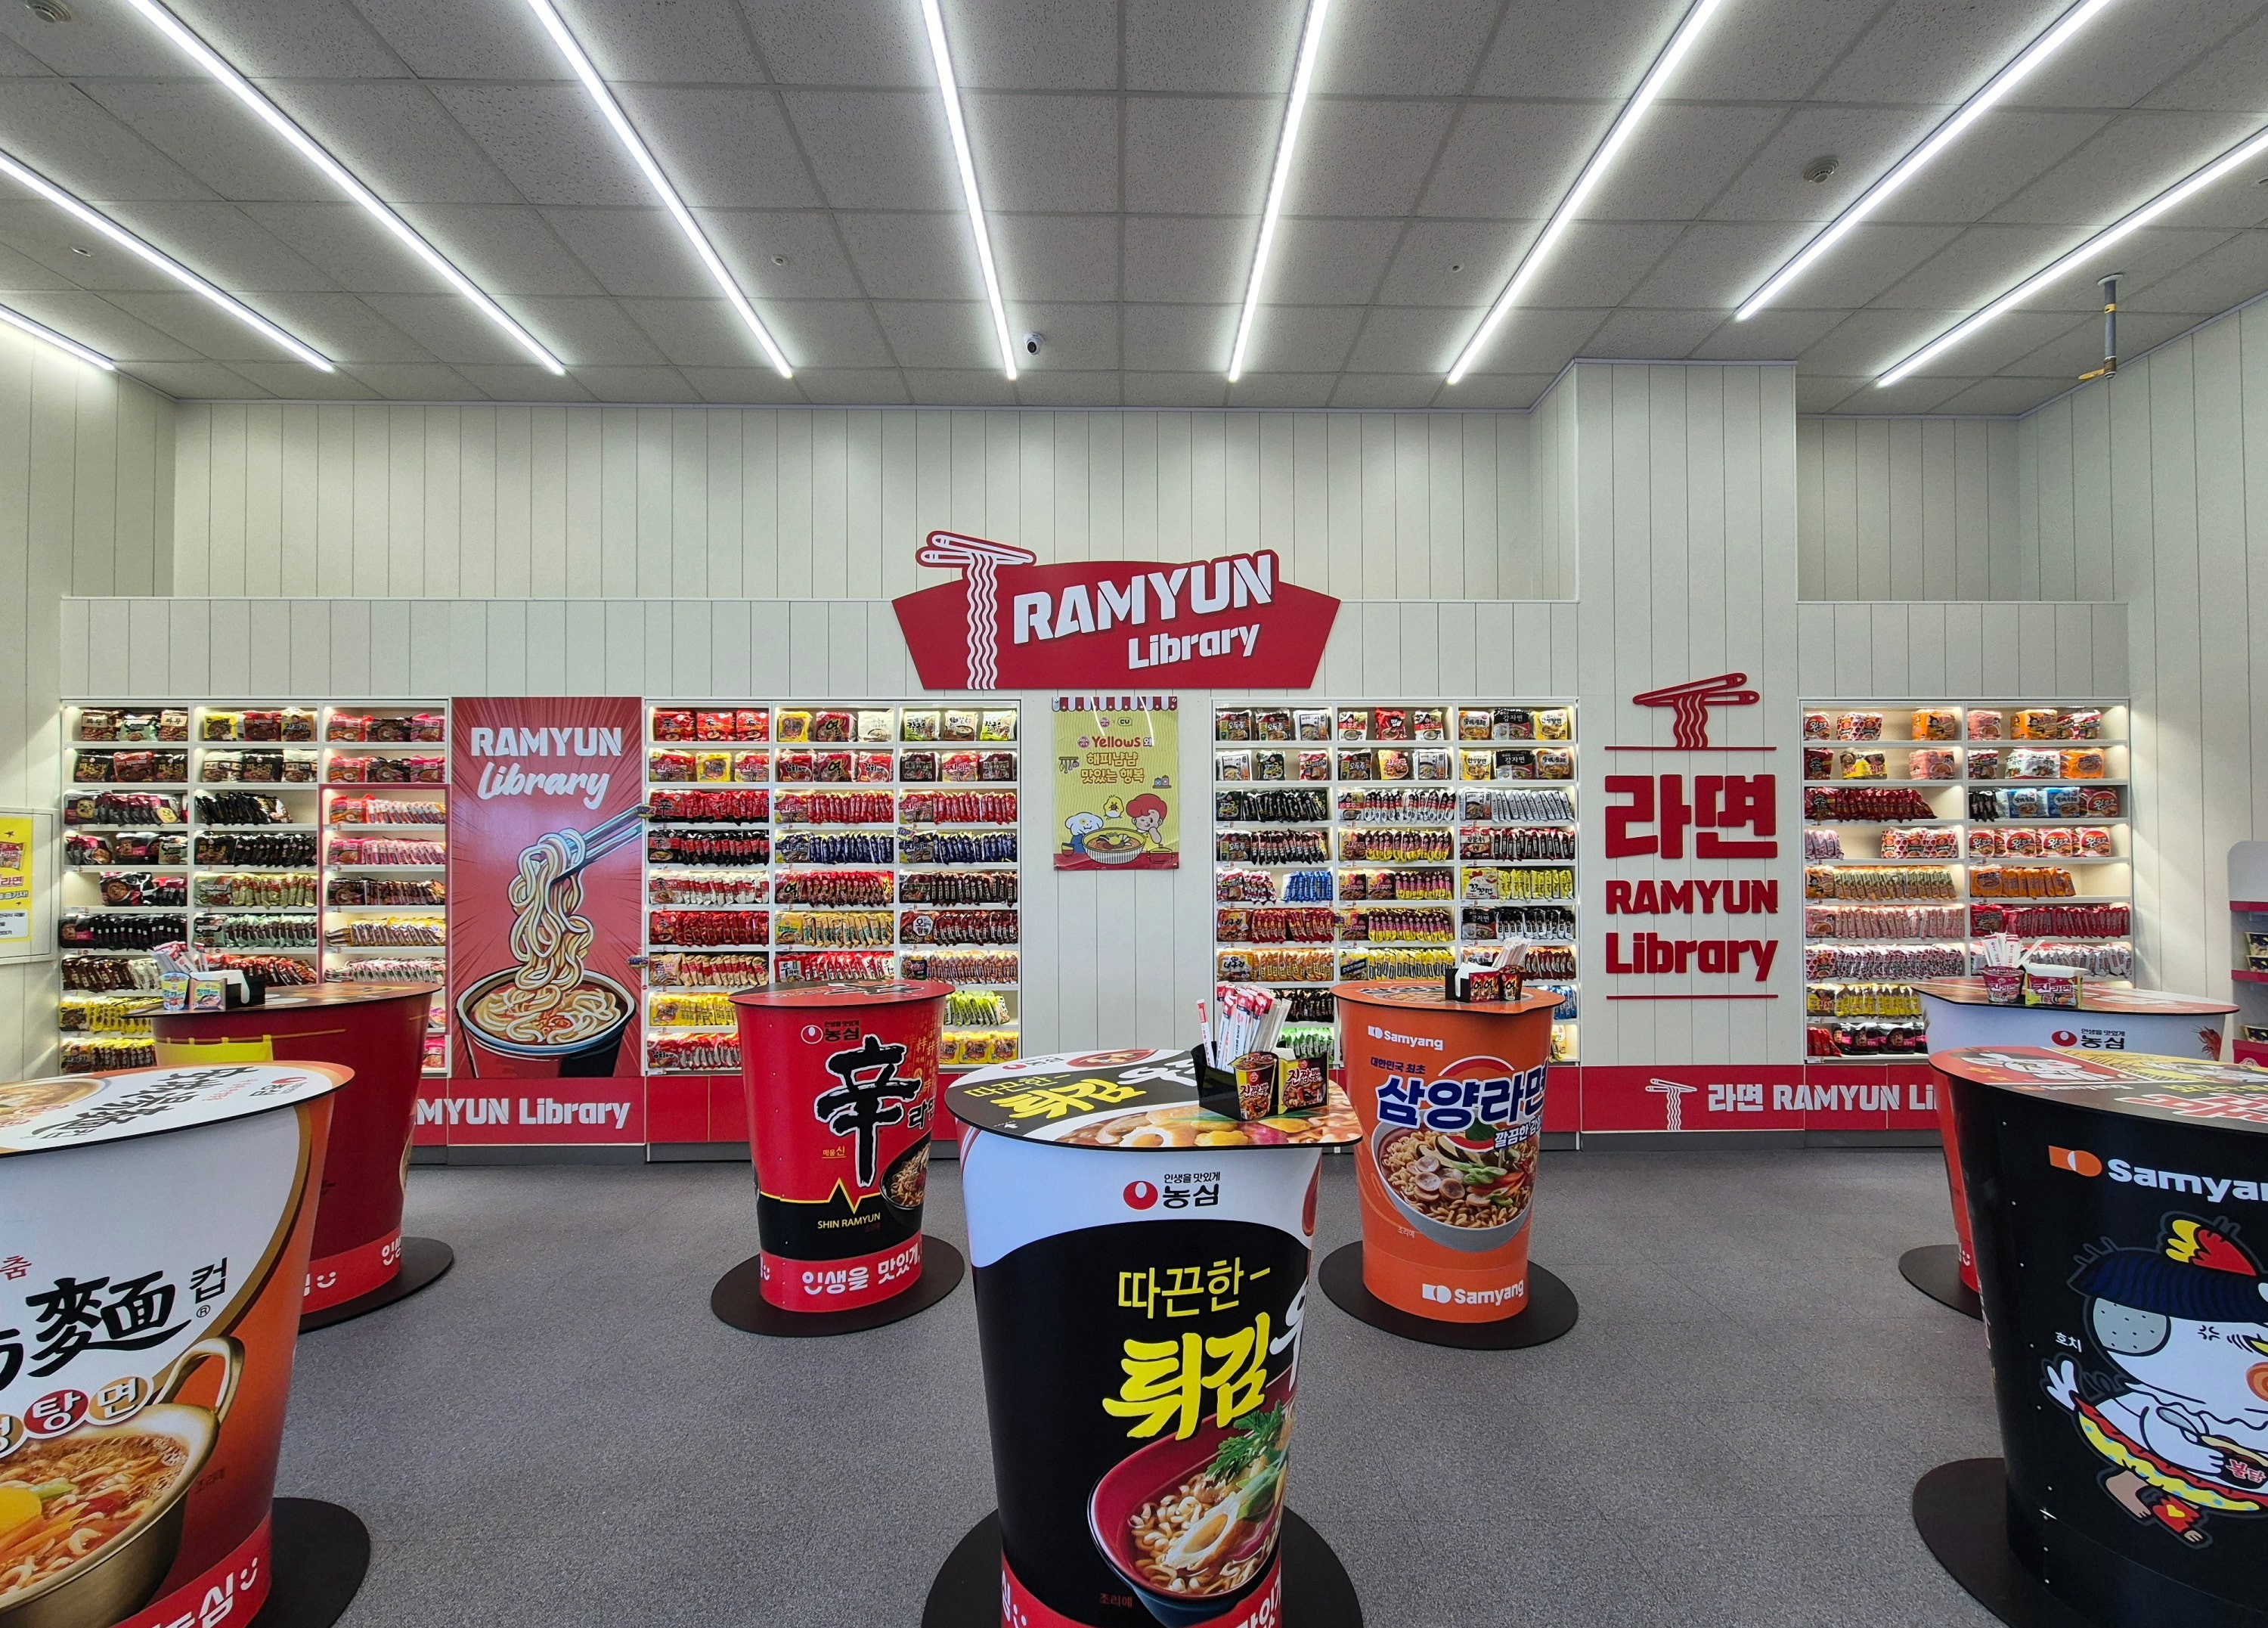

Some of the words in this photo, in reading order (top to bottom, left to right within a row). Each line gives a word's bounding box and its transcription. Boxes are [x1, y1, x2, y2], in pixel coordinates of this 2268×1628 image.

[1013, 554, 1272, 646] RAMYUN
[1127, 624, 1260, 670] Library
[470, 727, 622, 756] RAMYUN
[1086, 752, 1139, 767] 해피냠냠
[477, 761, 609, 809] Library
[1081, 768, 1117, 784] 맛있는
[1120, 768, 1145, 784] 행복
[1604, 774, 1778, 859] 라면
[1605, 879, 1778, 915] RAMYUN
[1605, 932, 1778, 981] Library
[824, 1027, 860, 1043] 농심
[1383, 1029, 1443, 1051] Samyang
[2081, 1034, 2125, 1050] 농심
[1370, 1056, 1404, 1074] 대한민국
[1405, 1063, 1426, 1075] 최초
[814, 1033, 922, 1188] 辛
[1708, 1084, 1764, 1112] 라면
[1774, 1085, 1901, 1112] RAMYUN
[414, 1097, 509, 1125] MYUN
[519, 1097, 631, 1129] Library
[1495, 1124, 1528, 1149] 깔끔한
[1163, 1172, 1192, 1184] 인생을
[1192, 1171, 1222, 1183] 맛있게
[1162, 1183, 1220, 1209] 농심
[817, 1219, 840, 1229] SHIN
[841, 1211, 881, 1227] RAMYUN
[1397, 1226, 1415, 1240] 조리예
[0, 1255, 33, 1281] 춤
[189, 1257, 228, 1304] 컵
[802, 1266, 869, 1295] 인생을
[1454, 1283, 1524, 1307] Samyang
